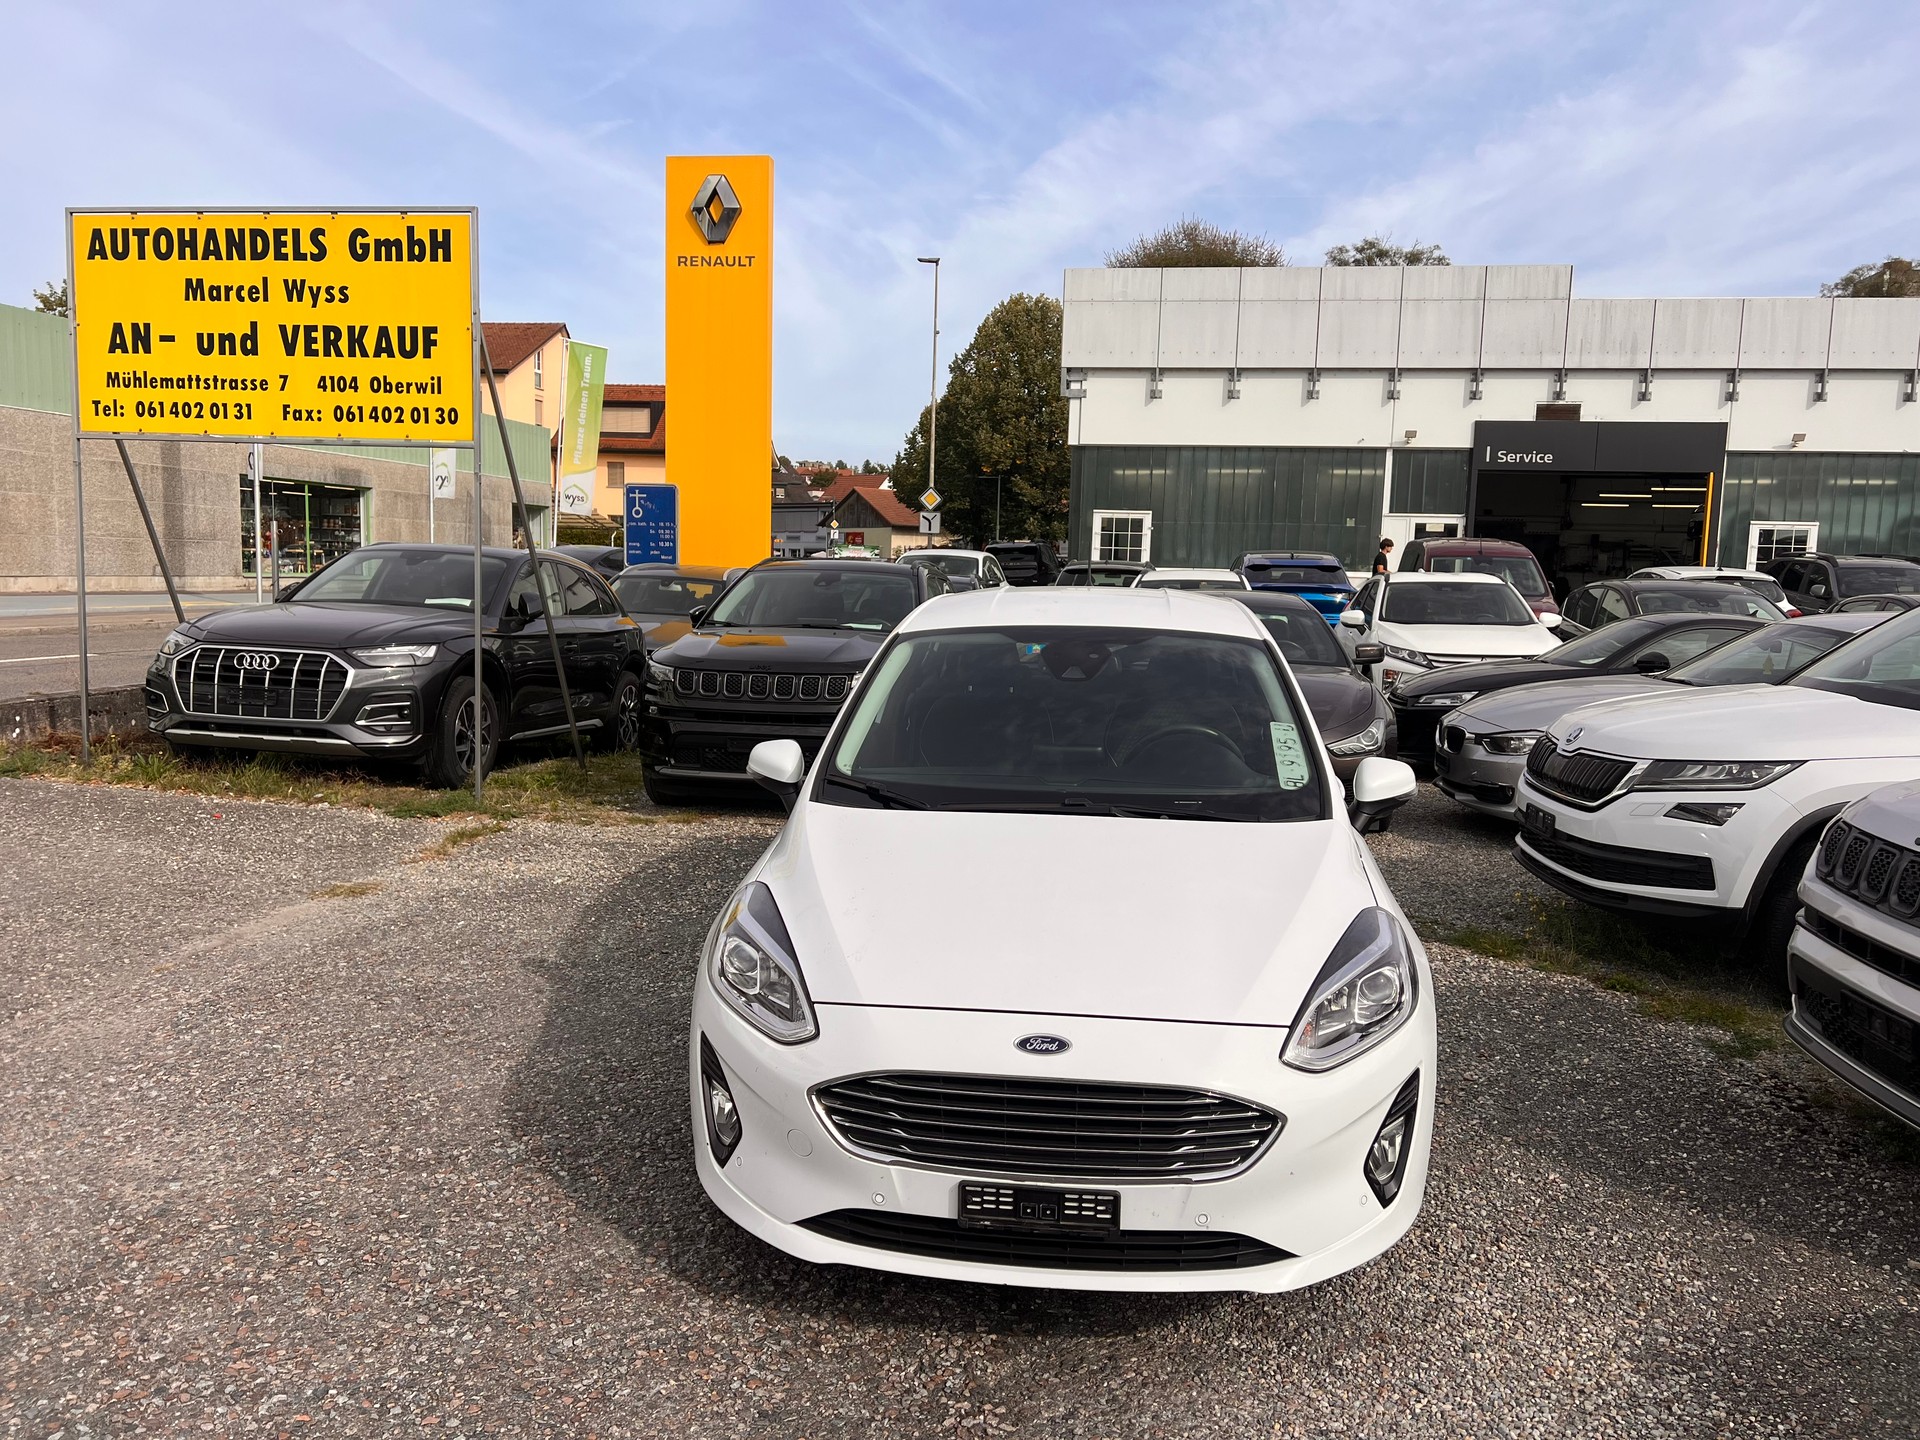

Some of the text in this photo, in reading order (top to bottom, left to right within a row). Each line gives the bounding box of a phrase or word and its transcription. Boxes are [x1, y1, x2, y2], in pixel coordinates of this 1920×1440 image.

[87, 225, 452, 263] AUTOHANDELS GmbH
[677, 255, 756, 267] RENAULT
[184, 276, 350, 309] Marcel Wyss
[196, 320, 259, 357] und
[278, 323, 439, 360] VERKAUF
[106, 370, 442, 395] Mühlemattstrasse 7 4104 Oberwil
[91, 398, 125, 418] Tel:
[282, 403, 322, 422] Fax:
[573, 353, 593, 465] Pflanze deinen Traum.
[1497, 449, 1554, 463] Service
[564, 493, 585, 508] wyss
[1026, 1037, 1059, 1051] Ford
